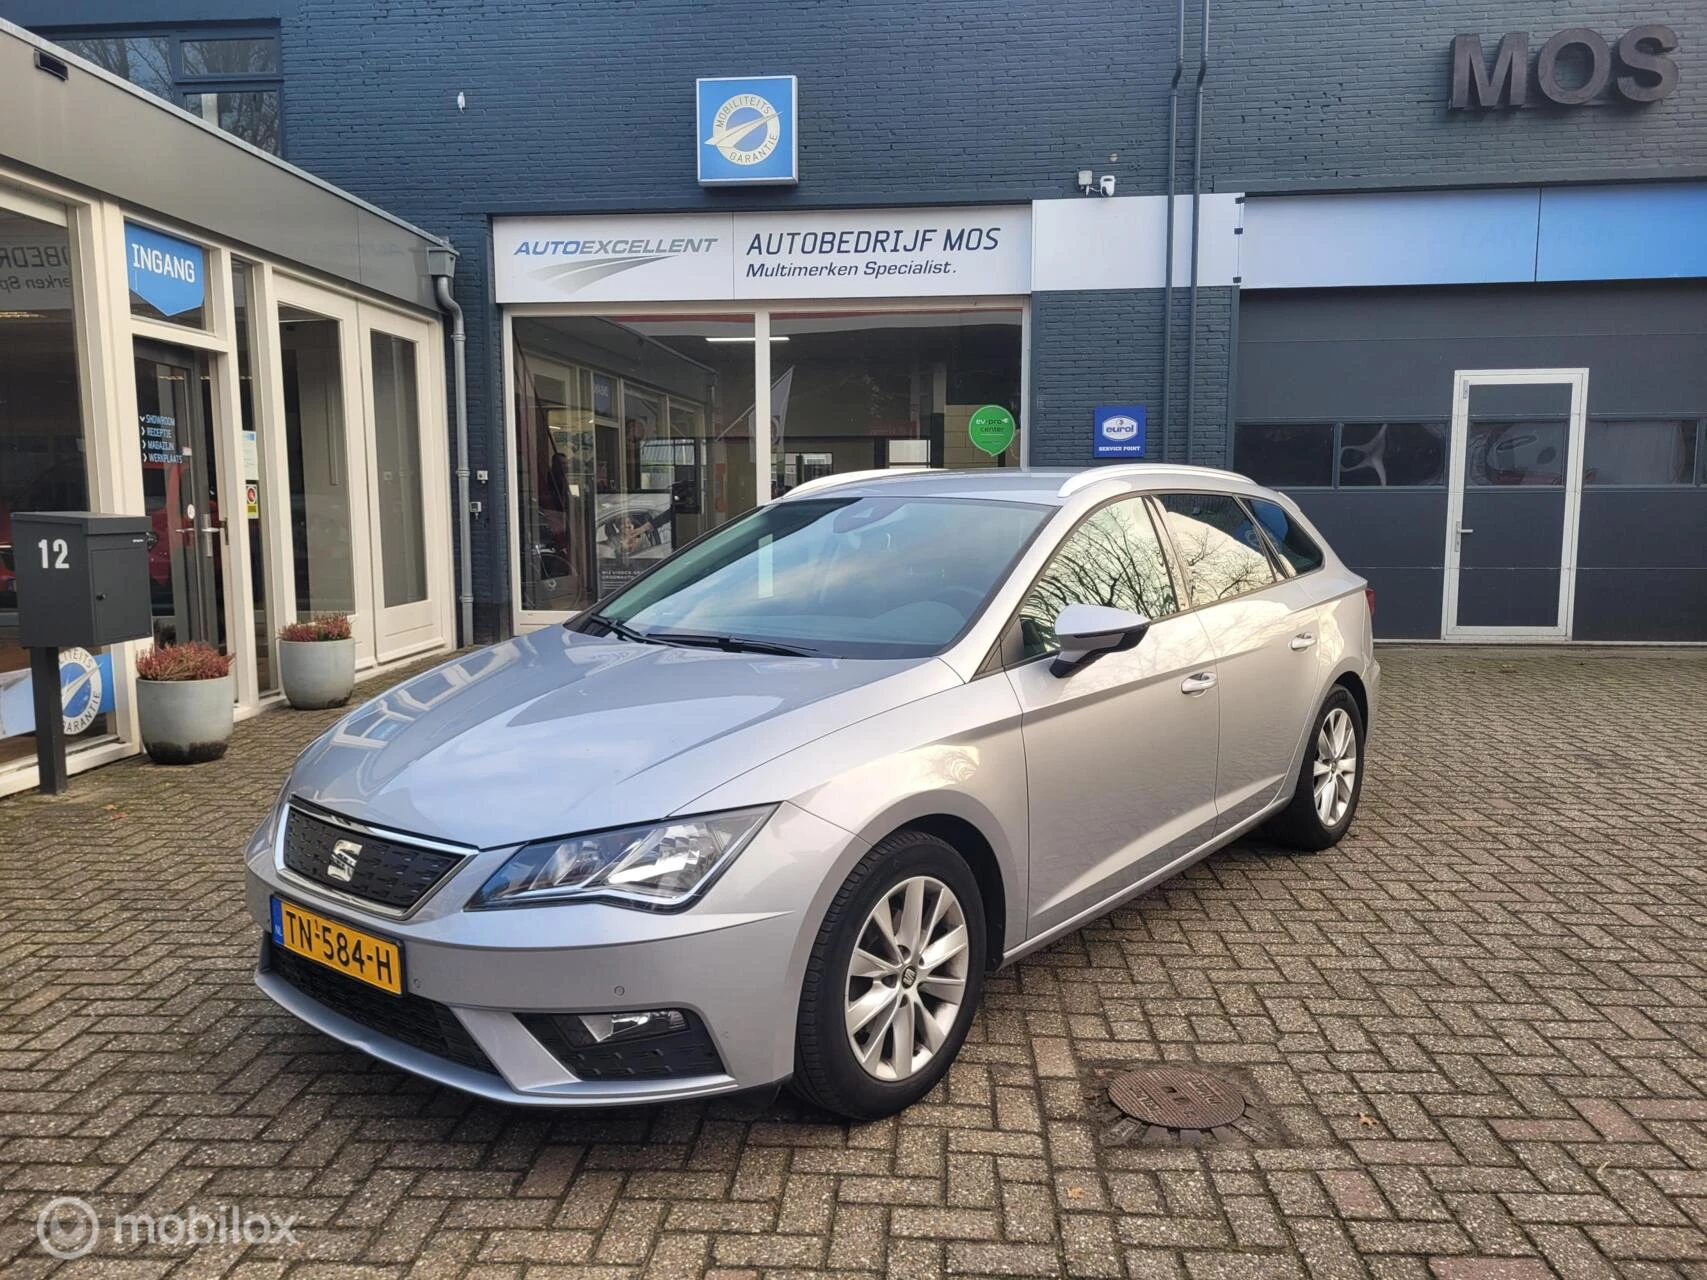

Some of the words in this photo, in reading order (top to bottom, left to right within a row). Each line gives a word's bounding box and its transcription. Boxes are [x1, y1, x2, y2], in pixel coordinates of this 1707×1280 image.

[1450, 24, 1679, 109] MOS
[716, 95, 772, 128] MOBILITEITS
[729, 134, 778, 164] GARANTIE
[513, 238, 719, 256] AUTOEXCELLENT
[746, 229, 938, 256] AUTOBEDRIJF
[942, 227, 1001, 252] MOS
[131, 243, 196, 284] INGANG
[746, 261, 859, 278] Multimerken
[863, 259, 957, 279] Specialist.
[145, 414, 176, 426] SHOWROOM
[1106, 425, 1134, 433] eurol
[146, 427, 172, 438] RECEPTIE
[147, 440, 175, 451] MAGAZIJN
[148, 453, 183, 464] WERKPLAATS
[38, 538, 70, 569] 12
[286, 910, 393, 985] TN-584-H
